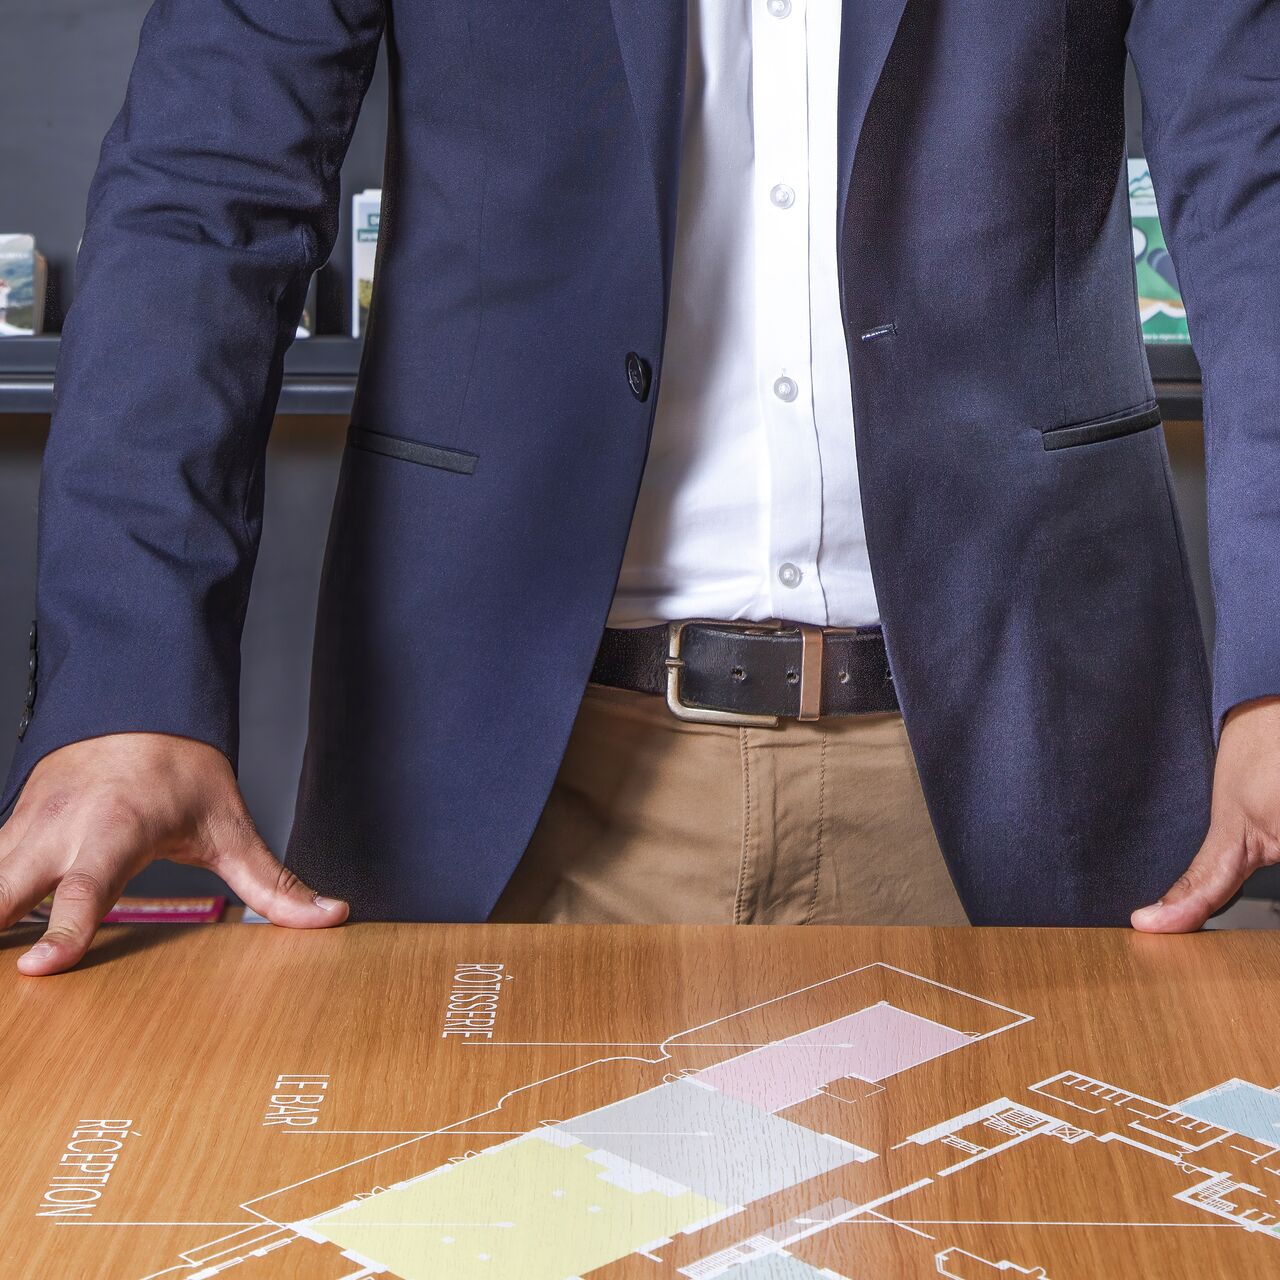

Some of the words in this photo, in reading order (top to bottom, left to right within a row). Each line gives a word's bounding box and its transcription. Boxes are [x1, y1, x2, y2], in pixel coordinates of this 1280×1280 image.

[441, 963, 515, 1039] RÔTISSERIE
[273, 1073, 331, 1089] LE
[262, 1093, 324, 1127] BAR
[34, 1118, 143, 1218] RÉCEPTION
